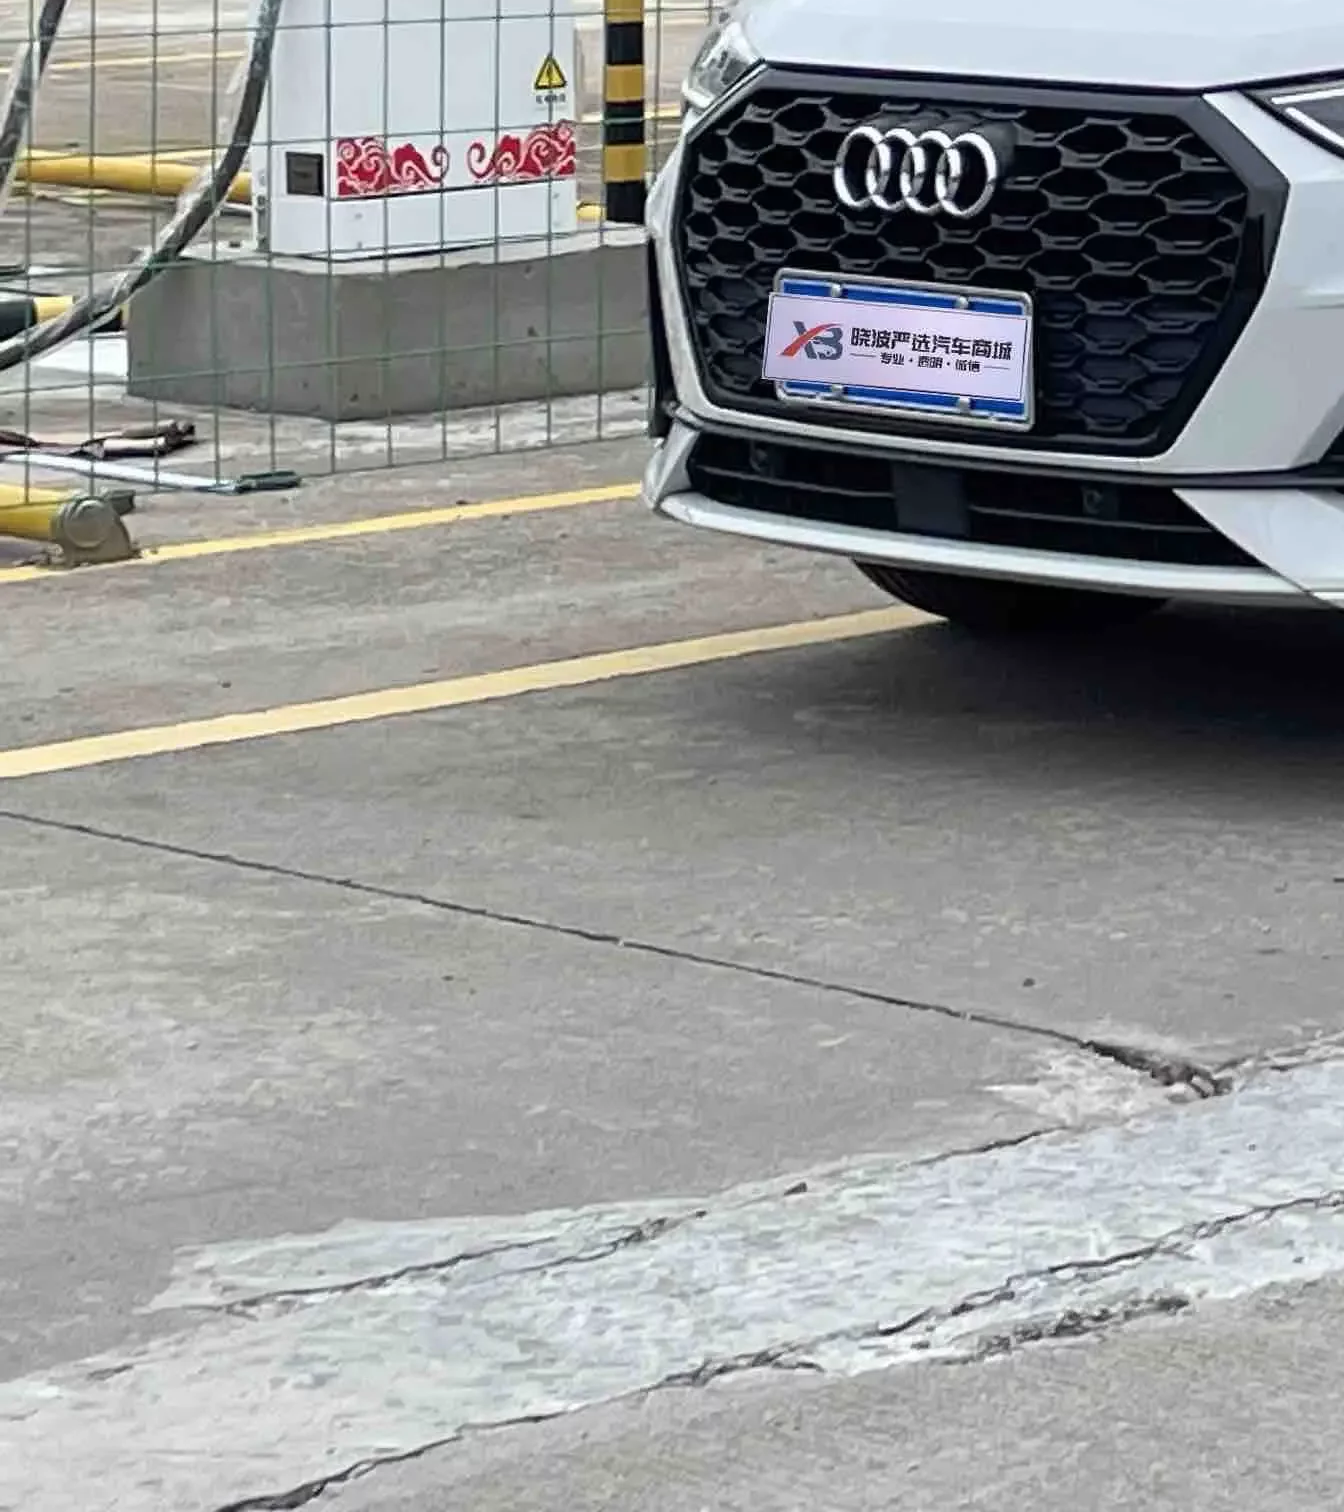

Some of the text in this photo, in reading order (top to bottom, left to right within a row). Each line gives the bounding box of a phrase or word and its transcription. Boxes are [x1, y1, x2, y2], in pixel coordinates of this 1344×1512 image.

[850, 327, 1013, 361] 晓波严选汽车商城
